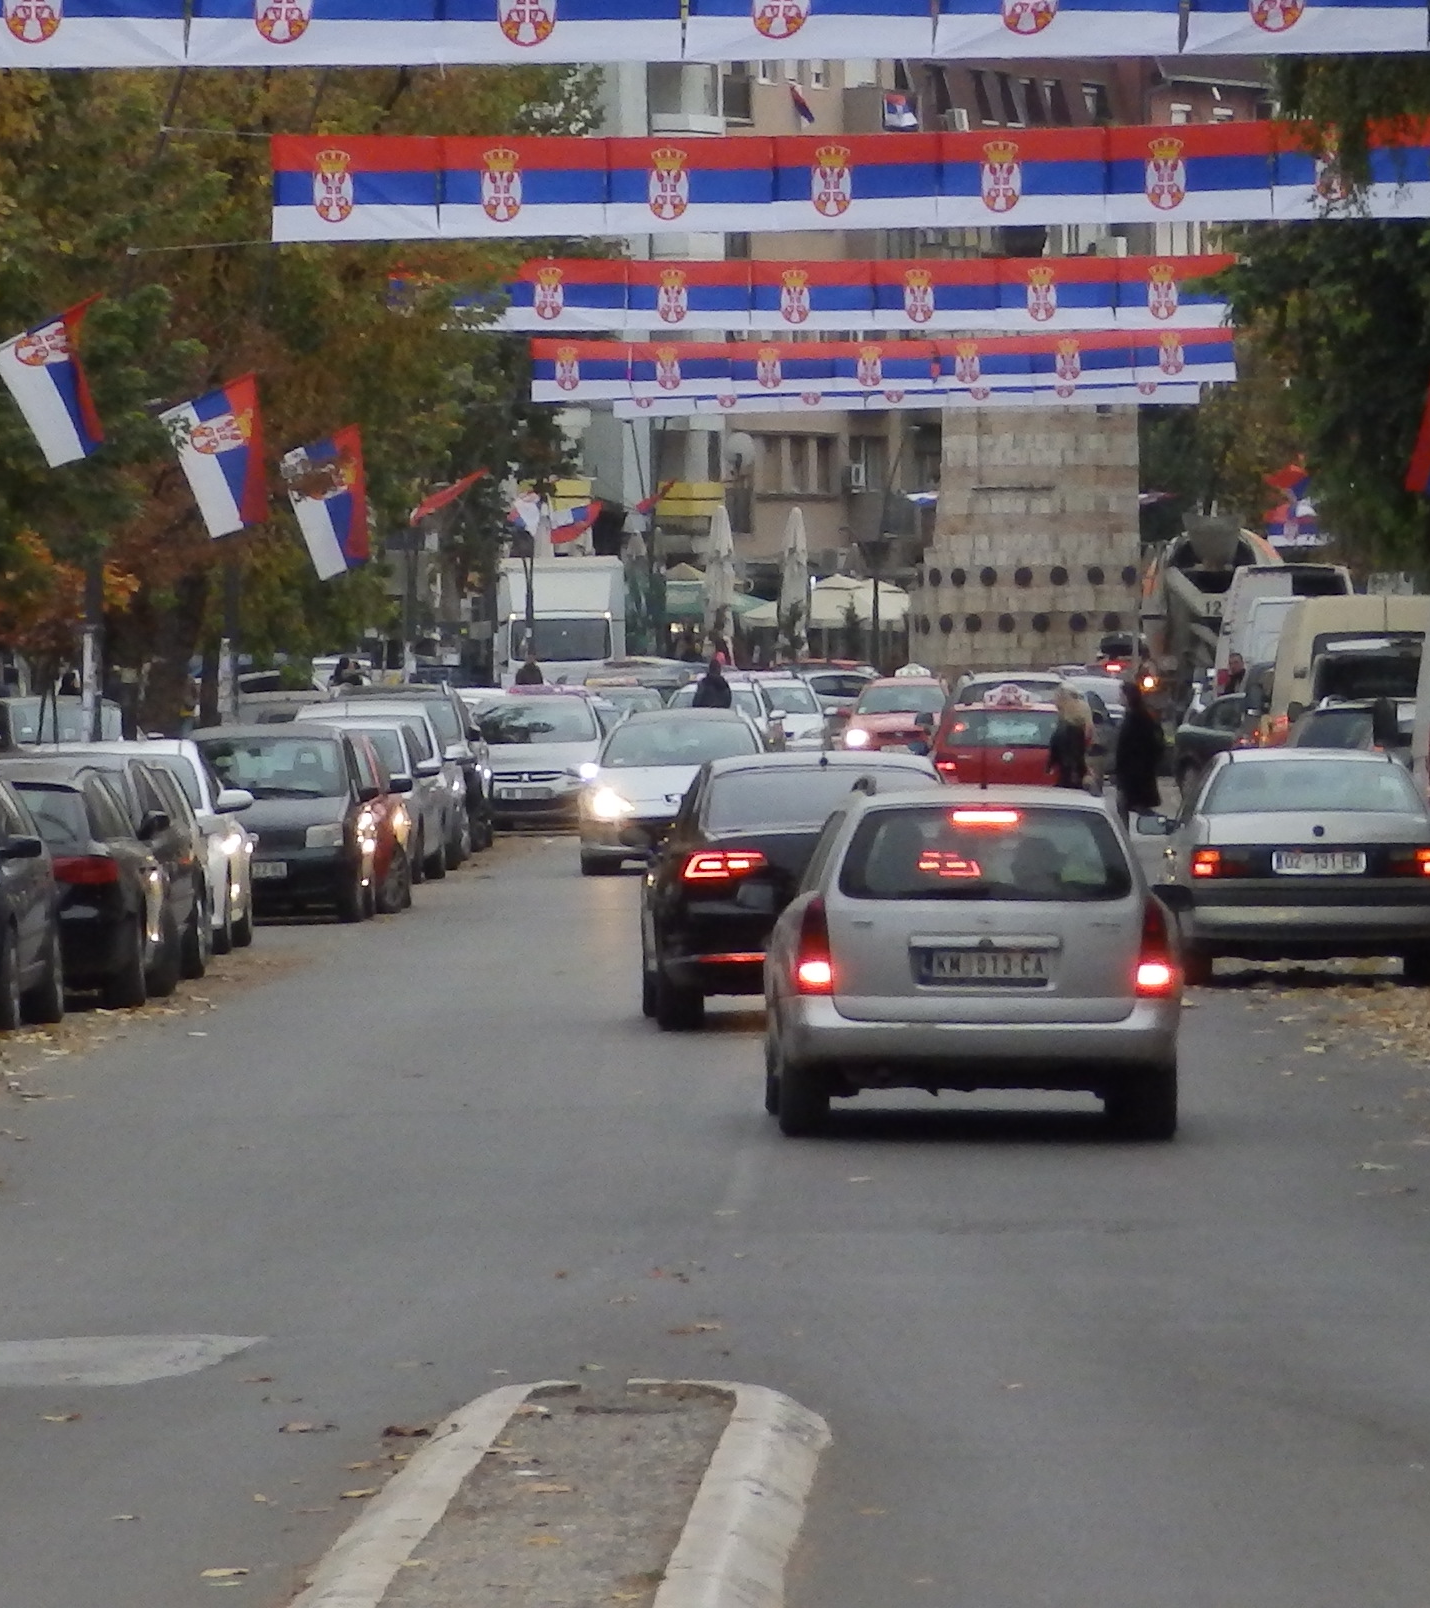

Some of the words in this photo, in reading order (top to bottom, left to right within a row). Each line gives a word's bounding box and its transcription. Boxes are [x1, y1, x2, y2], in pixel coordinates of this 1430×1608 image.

[1205, 600, 1223, 615] 12
[987, 693, 1030, 706] TAXI
[937, 954, 961, 974] KM
